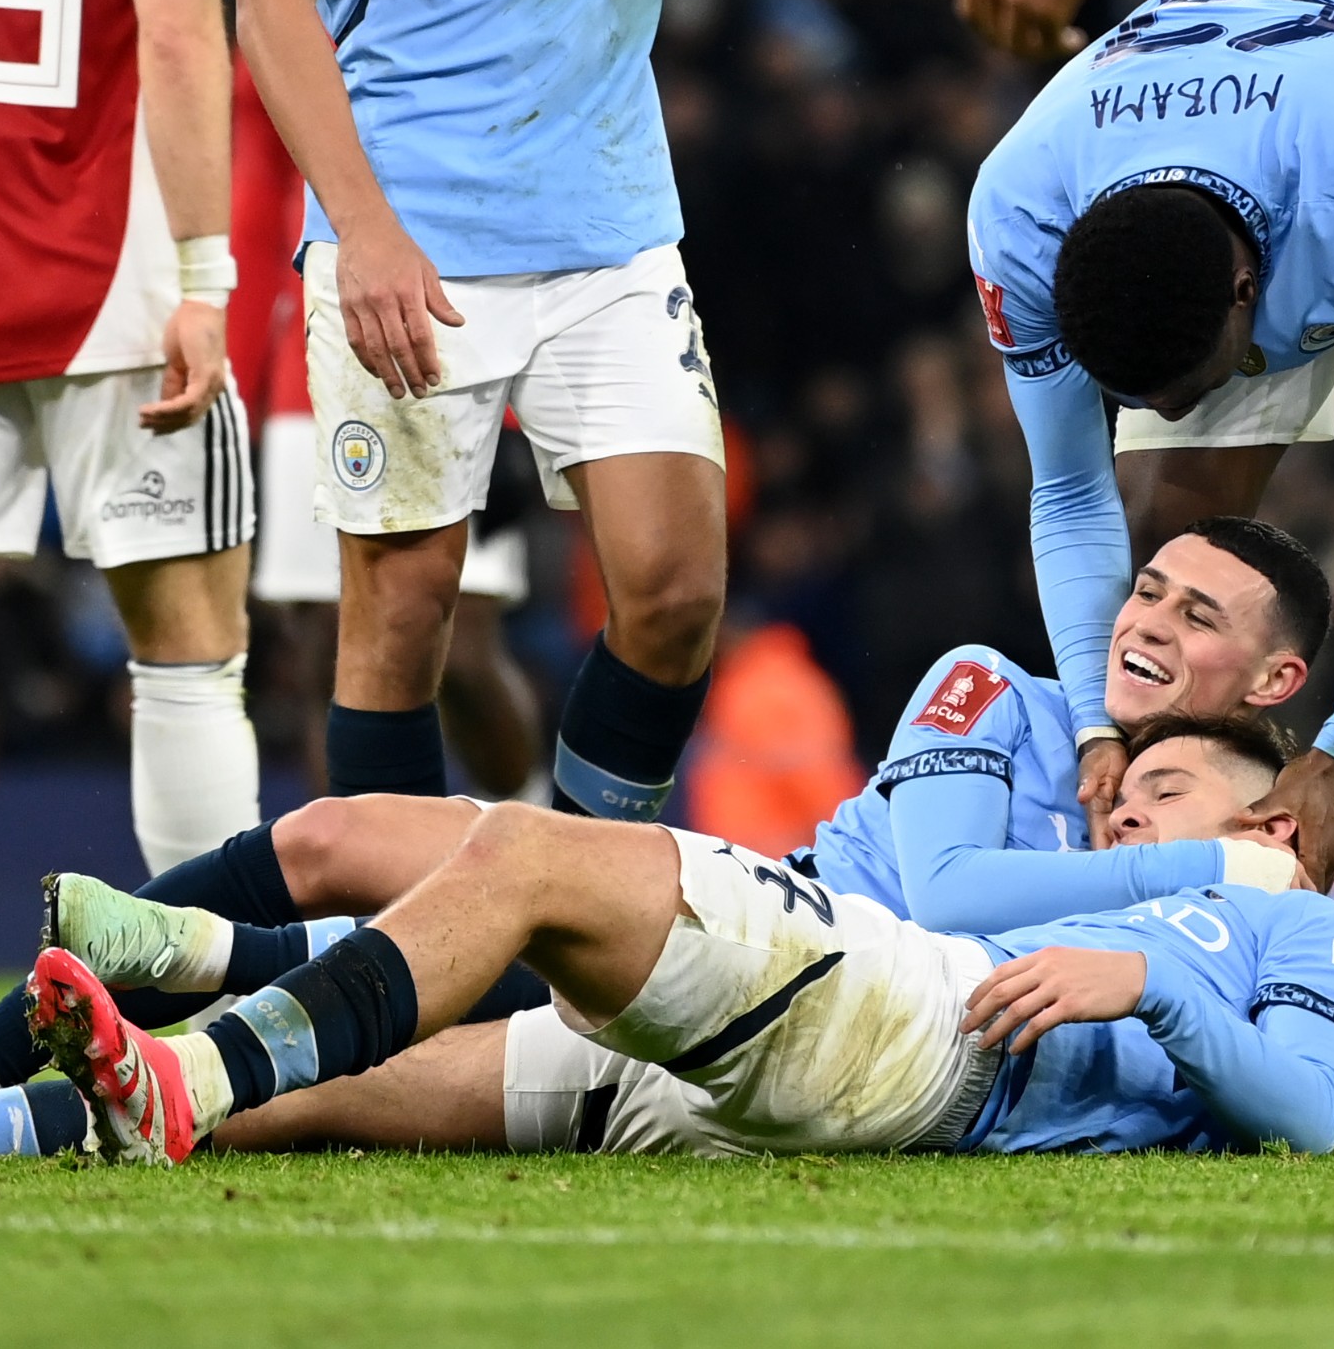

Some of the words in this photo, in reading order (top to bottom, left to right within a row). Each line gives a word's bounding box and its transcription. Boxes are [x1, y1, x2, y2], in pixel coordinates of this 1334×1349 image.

[1090, 73, 1285, 129] MUBAMA
[937, 706, 966, 723] CUP
[601, 790, 660, 812] CITY
